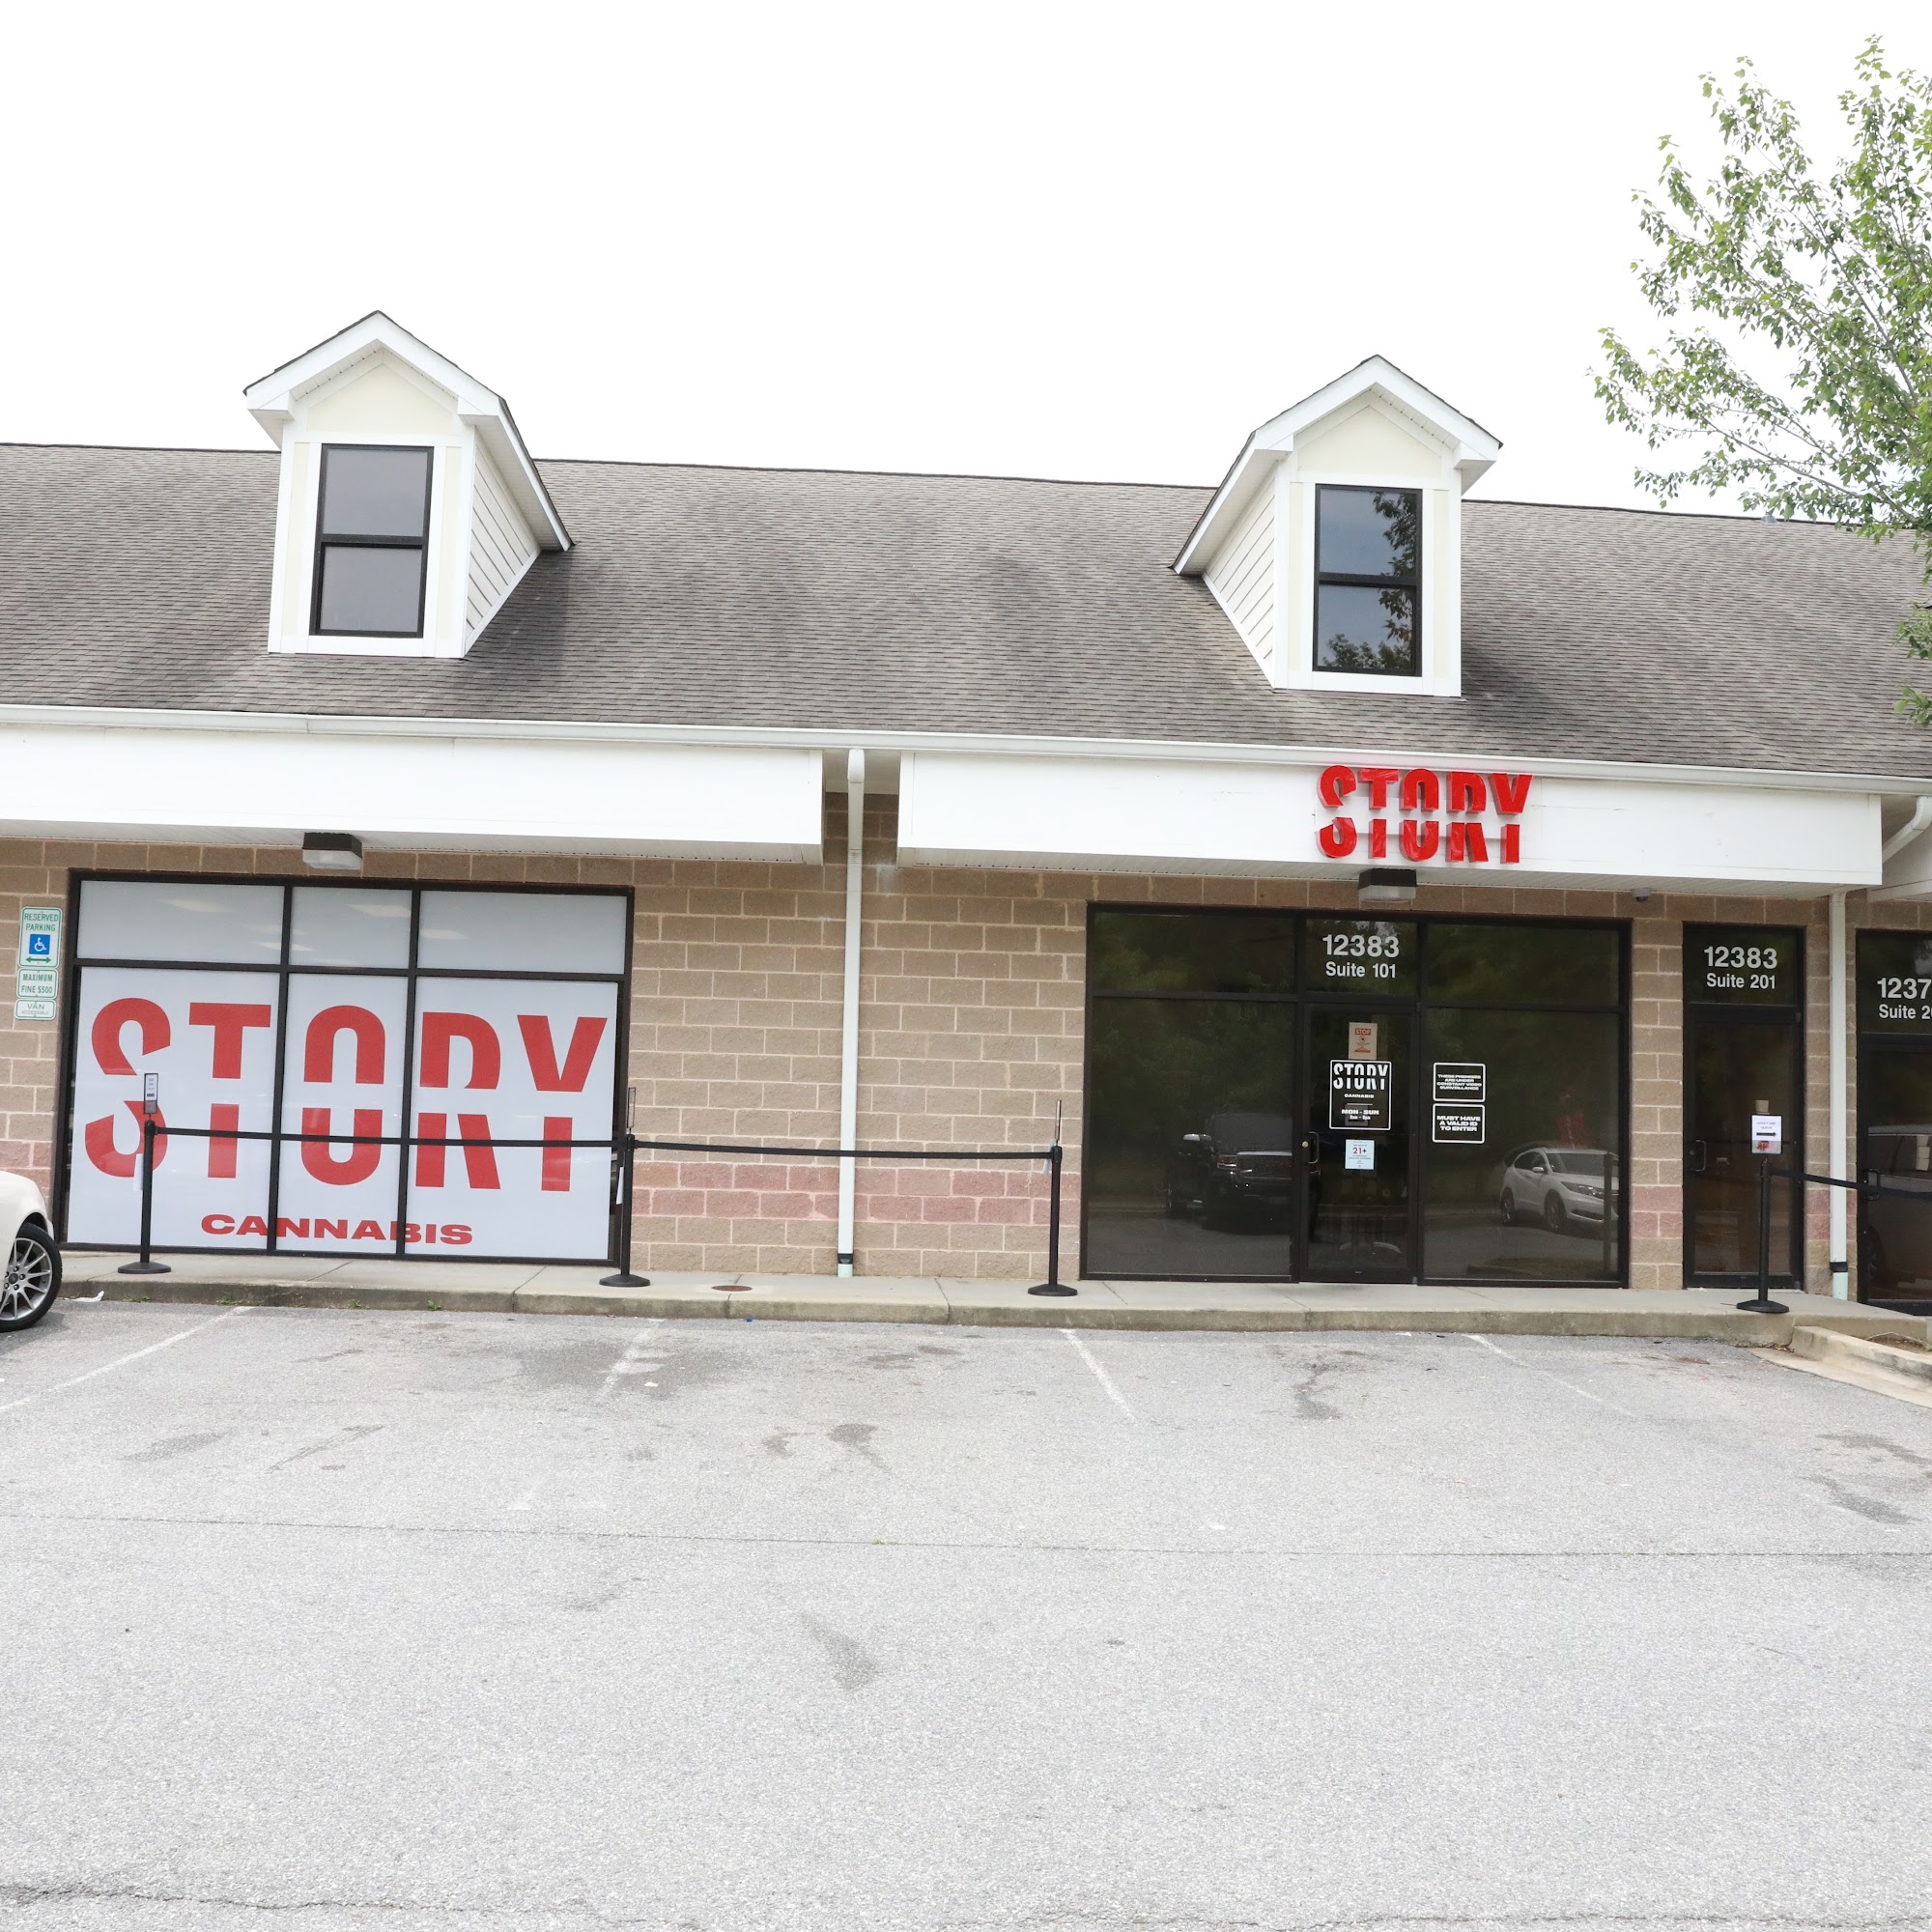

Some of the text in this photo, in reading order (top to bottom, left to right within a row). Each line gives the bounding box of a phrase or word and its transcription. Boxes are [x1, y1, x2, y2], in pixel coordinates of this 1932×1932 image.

[1317, 765, 1533, 865] STORY
[24, 913, 58, 922] RESERVED
[1321, 934, 1400, 958] 12383
[1704, 946, 1778, 970] 12383
[22, 973, 53, 982] MAXIMUM
[1325, 961, 1396, 979] Suite 101
[38, 985, 53, 994] $500
[1706, 973, 1776, 989] Suite 201
[1879, 1004, 1932, 1020] Suite 2
[1333, 1063, 1388, 1091] STORY
[85, 997, 608, 1192] STORY
[201, 1213, 473, 1245] CANNABIS
